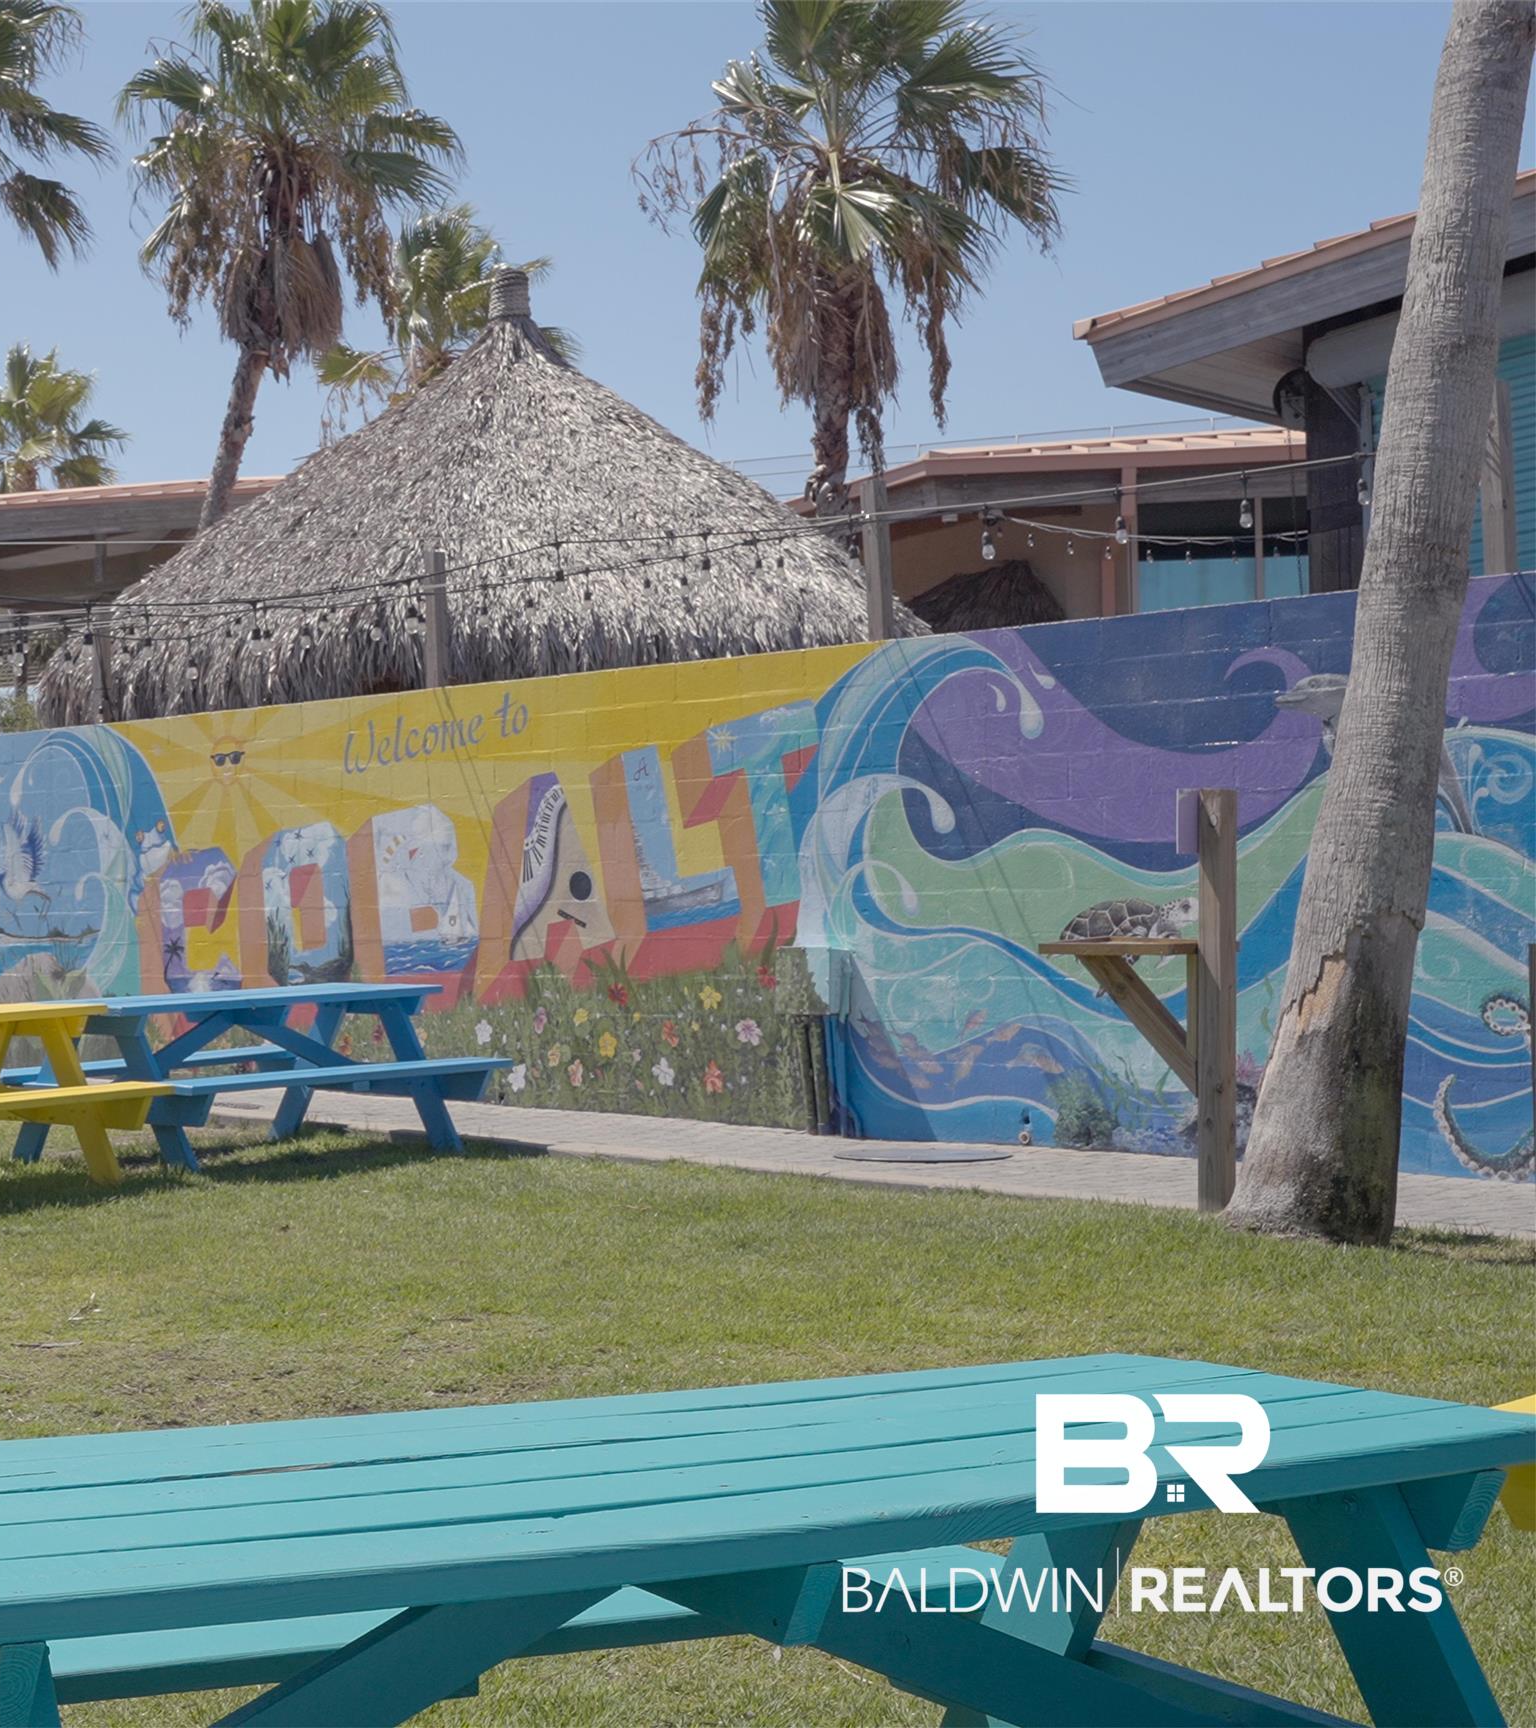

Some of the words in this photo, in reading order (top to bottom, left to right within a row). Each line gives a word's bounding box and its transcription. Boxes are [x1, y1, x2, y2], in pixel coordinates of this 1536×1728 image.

[344, 714, 486, 774] Welcome
[495, 691, 529, 738] to
[148, 698, 818, 996] COBALT
